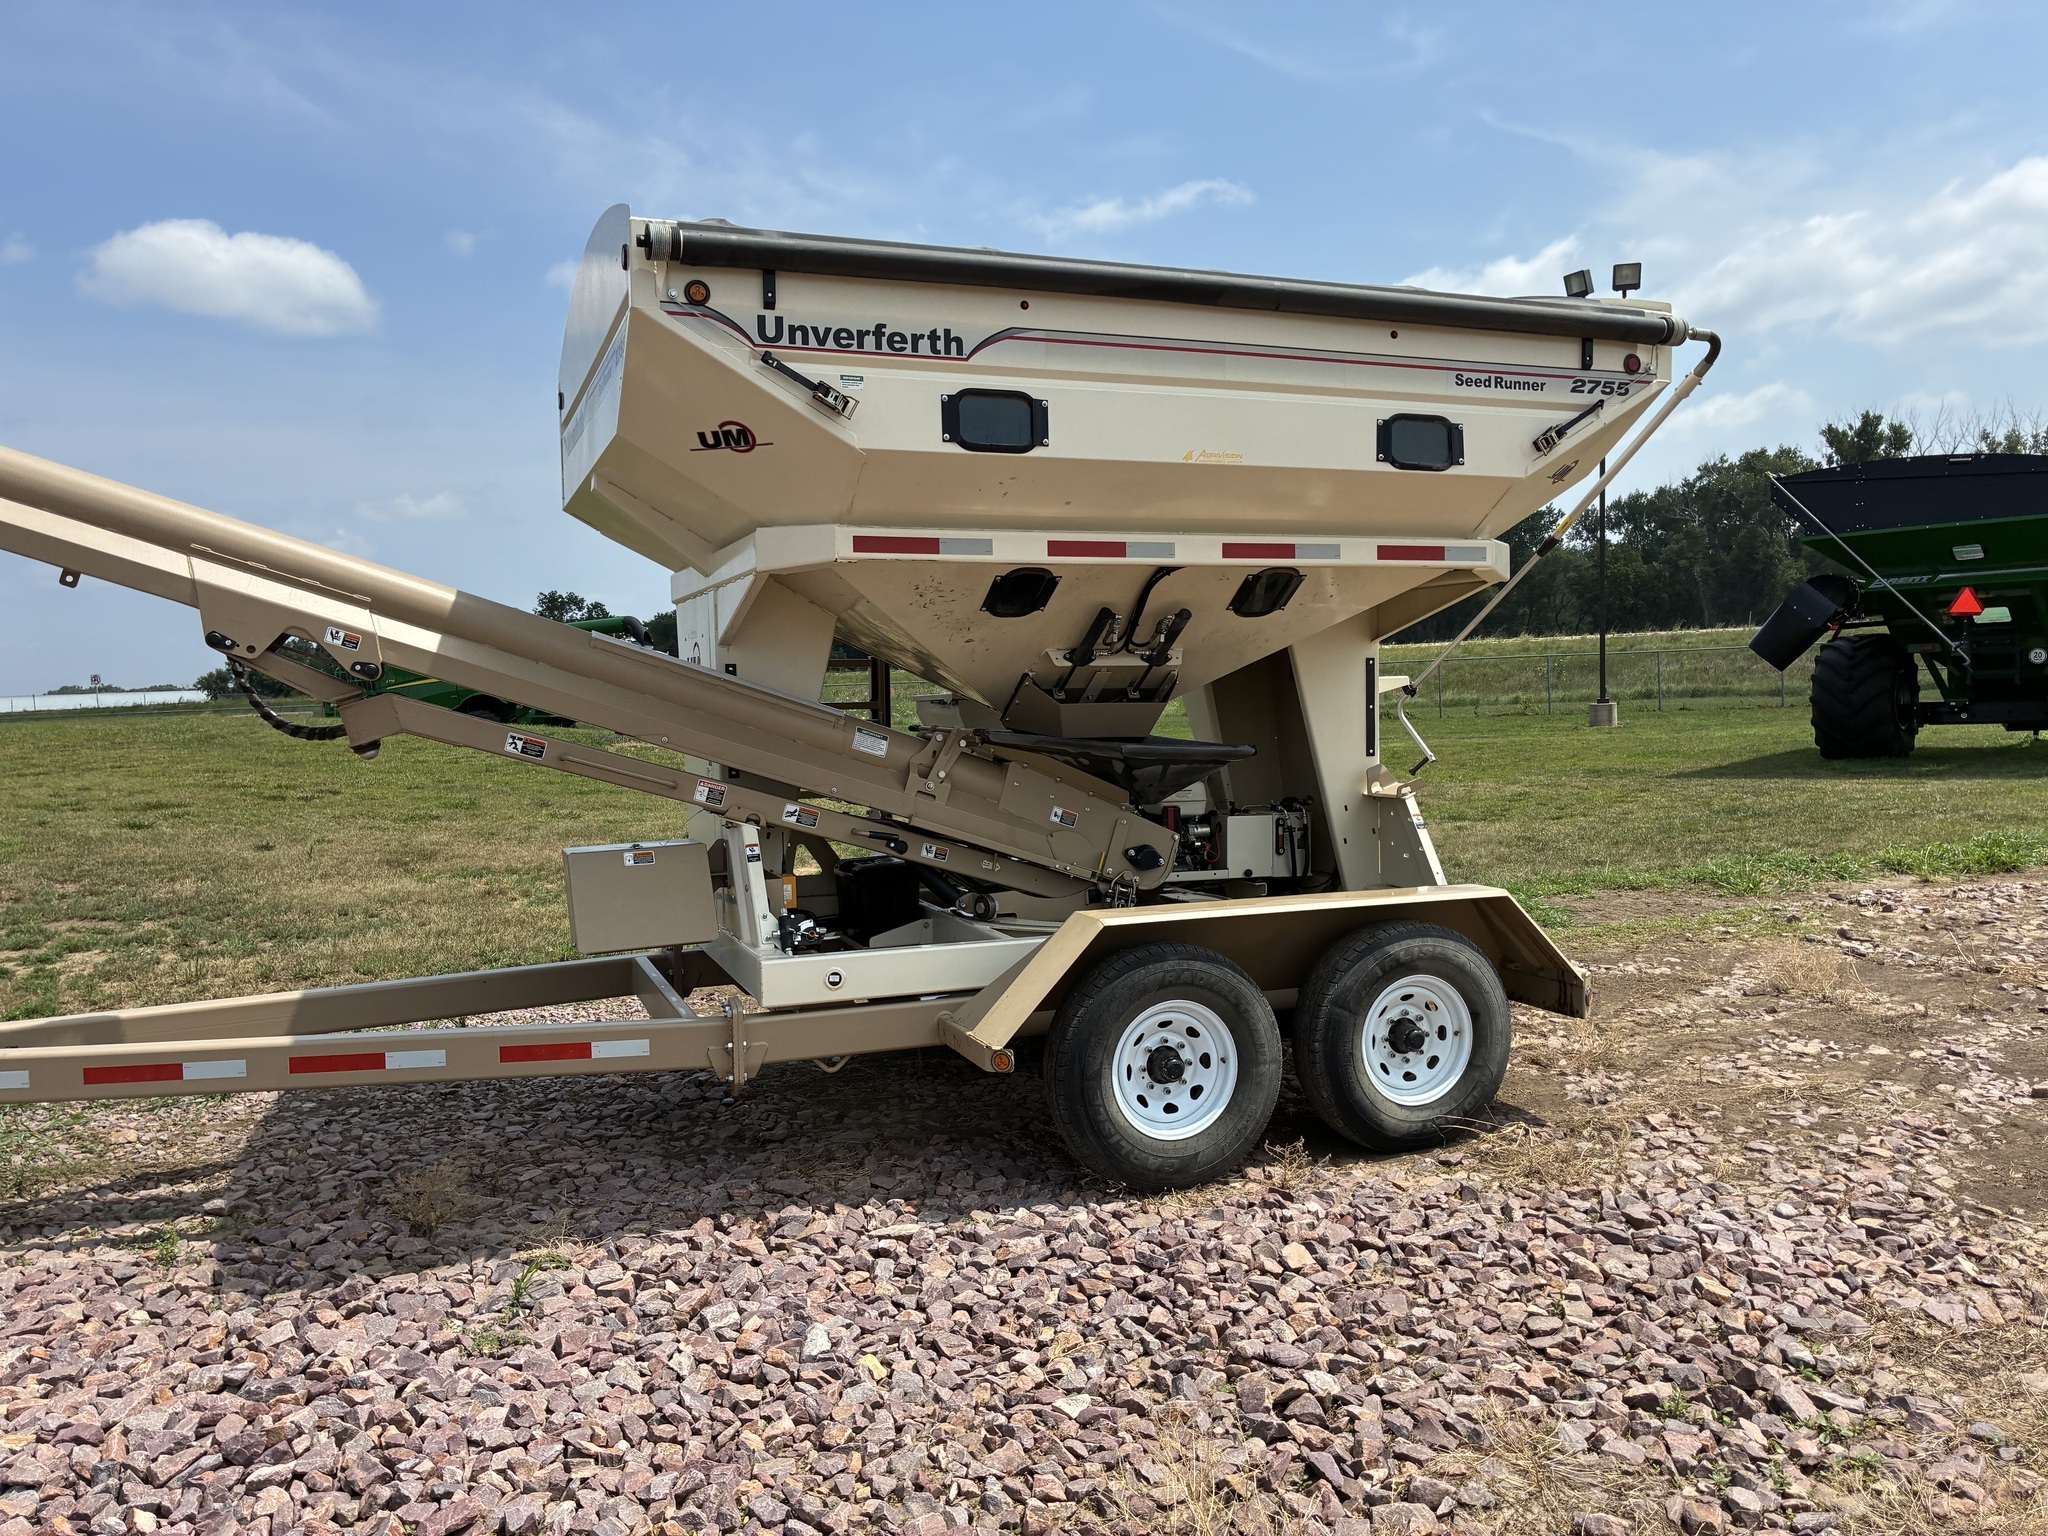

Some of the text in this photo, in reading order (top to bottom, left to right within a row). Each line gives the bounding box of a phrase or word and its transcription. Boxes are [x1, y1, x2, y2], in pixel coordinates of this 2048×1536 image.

[757, 314, 964, 357] Unverferth
[1455, 373, 1546, 392] Seed Runner
[1570, 378, 1630, 397] 2755
[696, 428, 751, 449] UM
[2033, 651, 2043, 659] 20
[703, 783, 726, 792] DANGER
